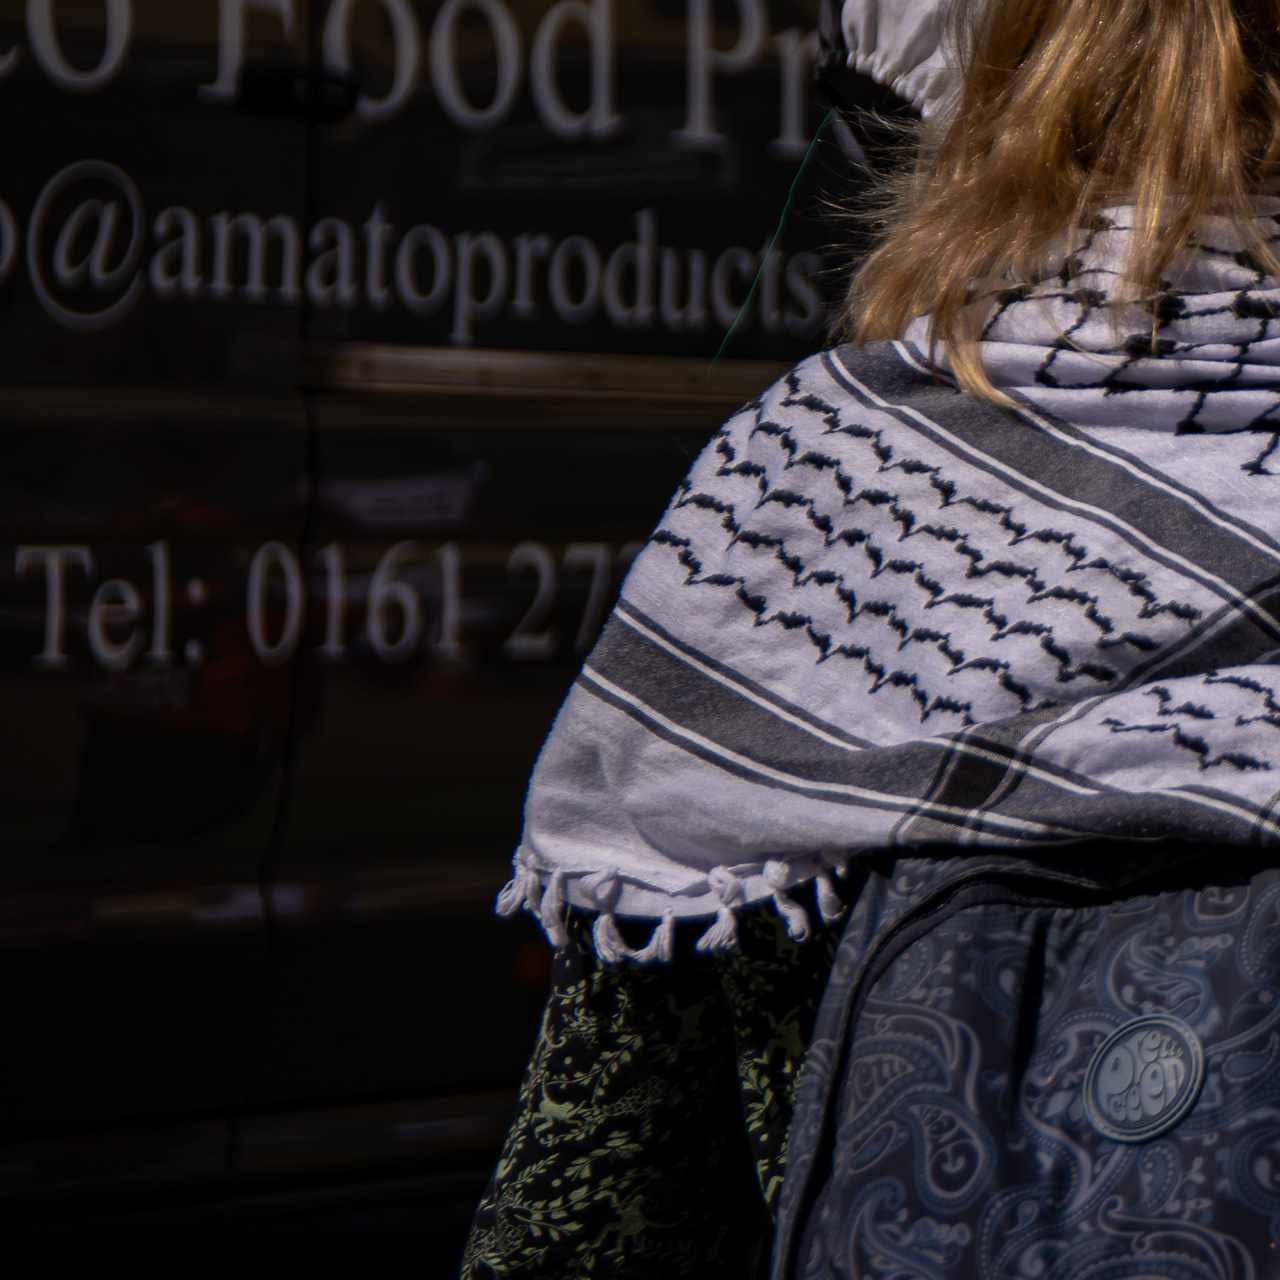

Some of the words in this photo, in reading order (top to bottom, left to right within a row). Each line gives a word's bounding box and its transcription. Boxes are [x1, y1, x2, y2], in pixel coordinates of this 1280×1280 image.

[14, 537, 208, 671] Tel:
[245, 539, 467, 667] 0161
[502, 539, 650, 662] 27
